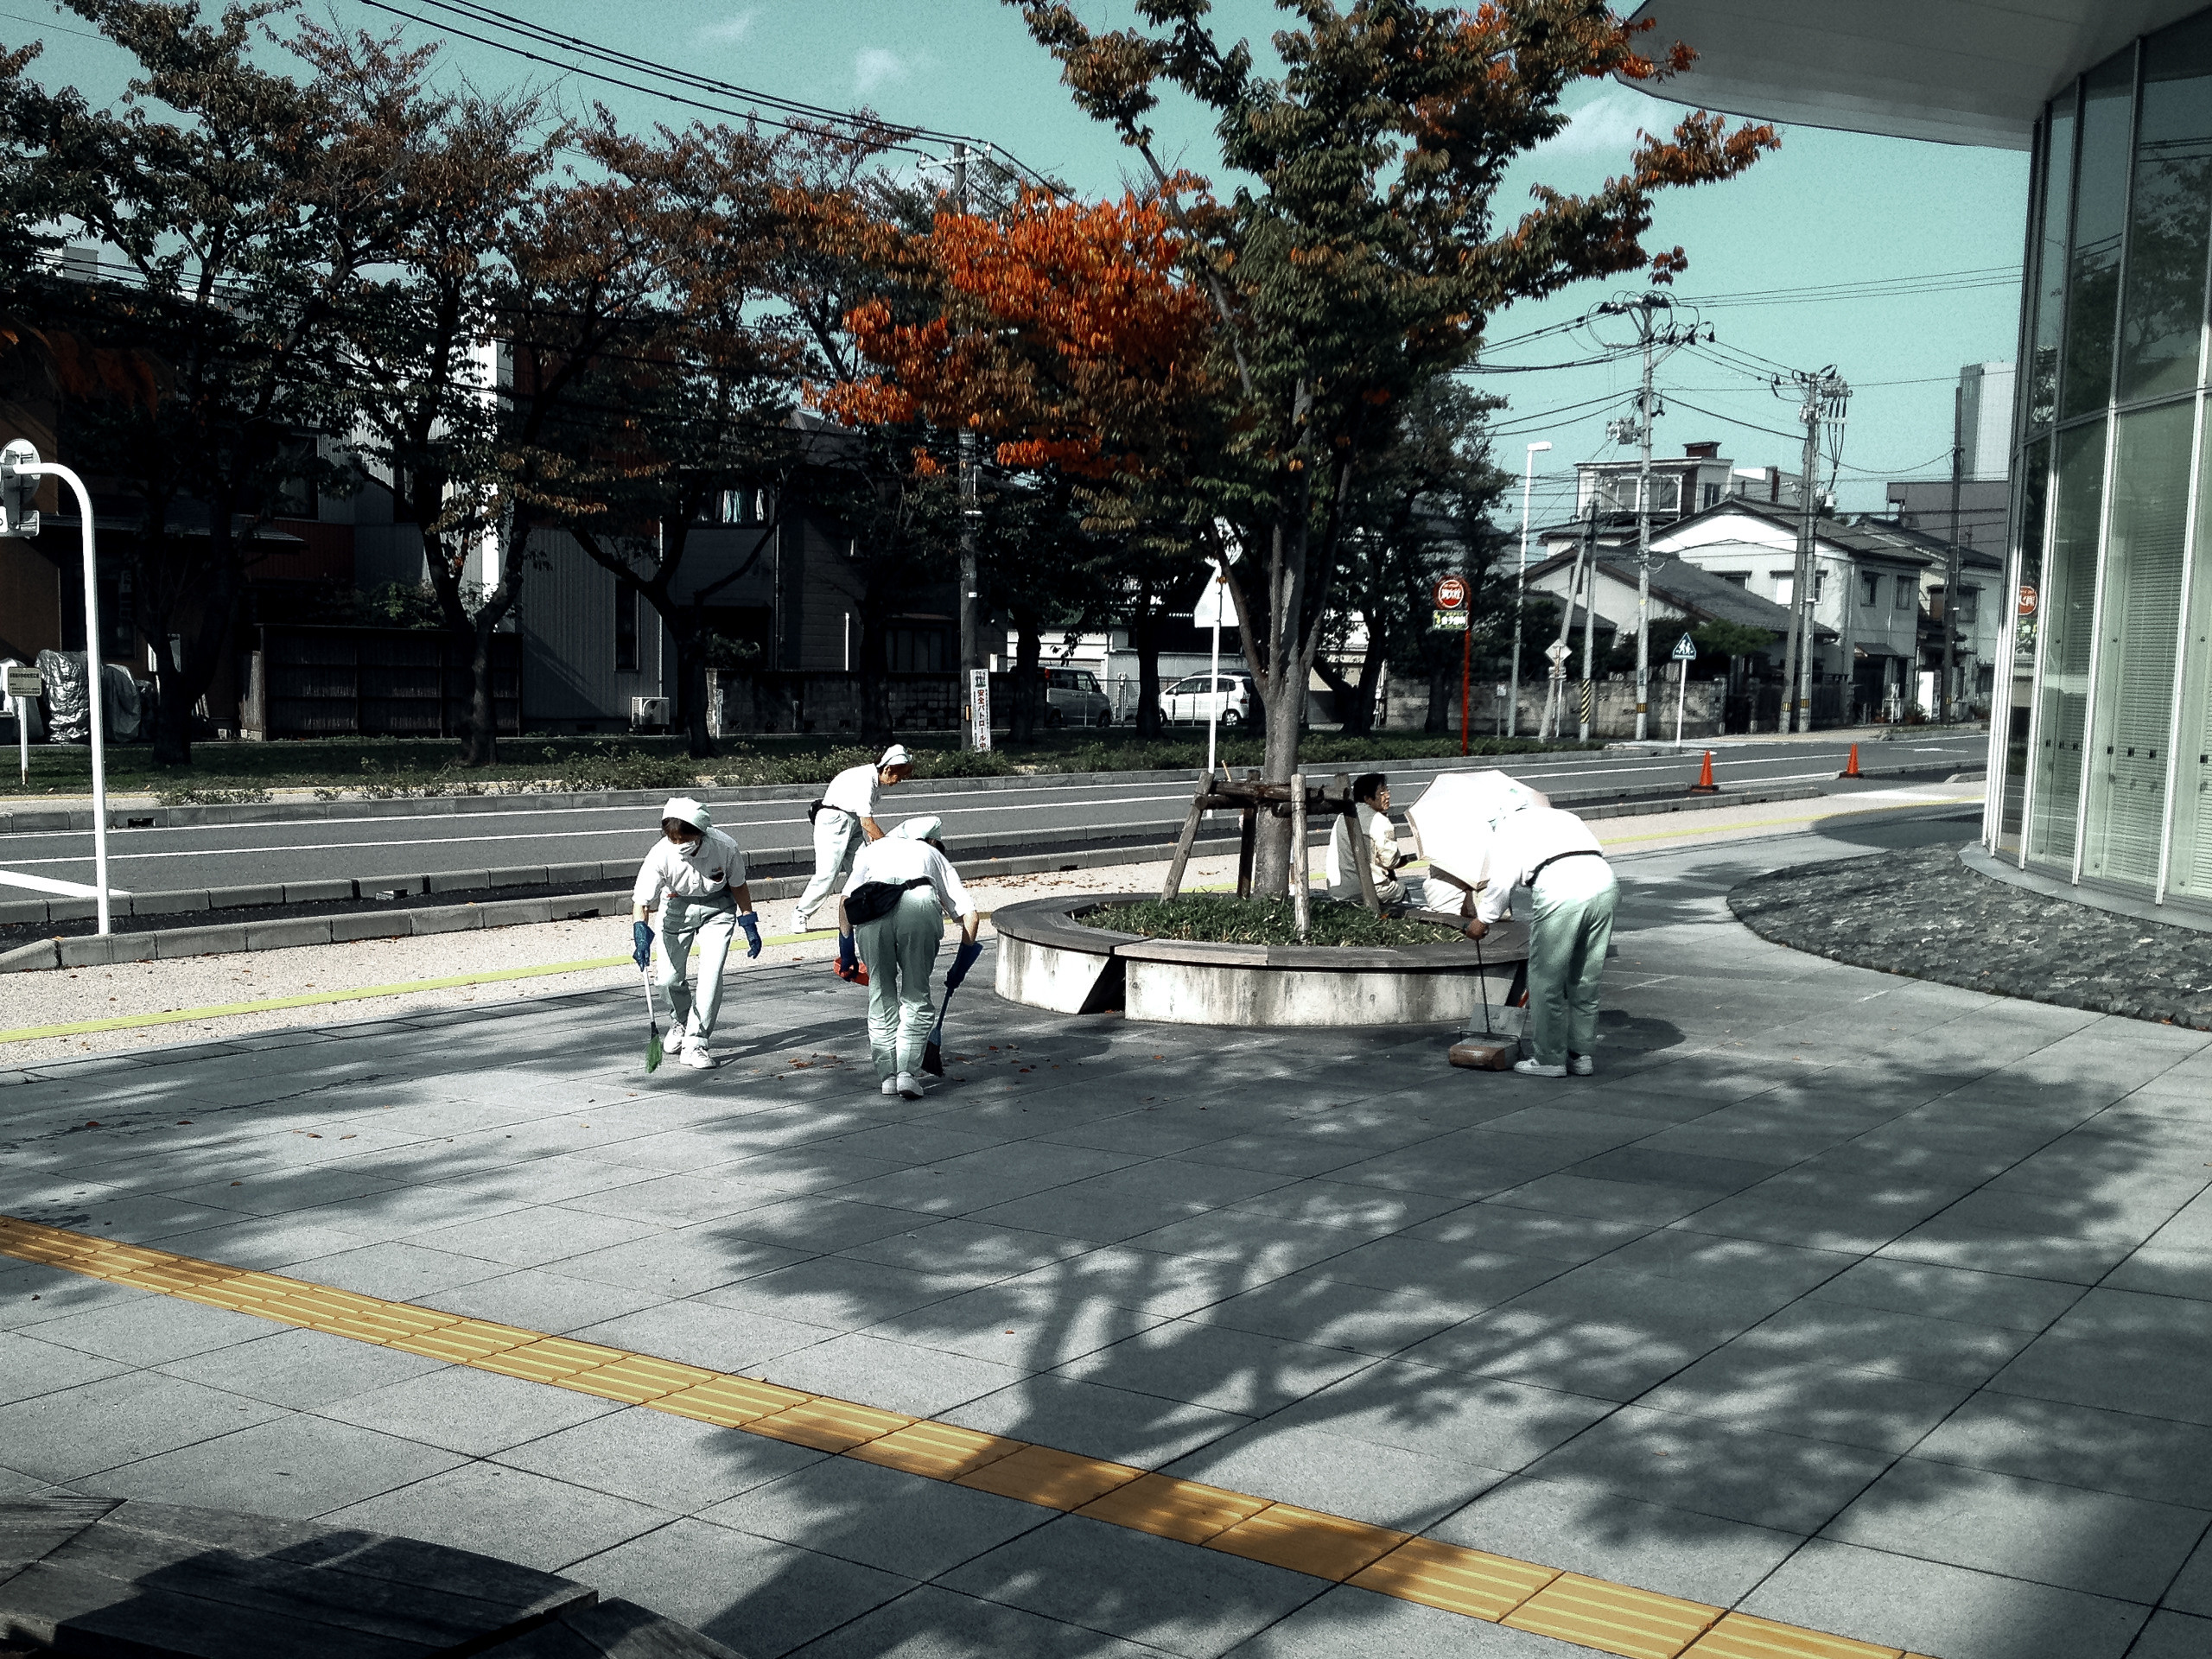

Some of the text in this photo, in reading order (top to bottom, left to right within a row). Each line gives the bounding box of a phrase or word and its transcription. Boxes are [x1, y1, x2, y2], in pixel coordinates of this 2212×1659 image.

[977, 689, 986, 749] 安全パトロール中
